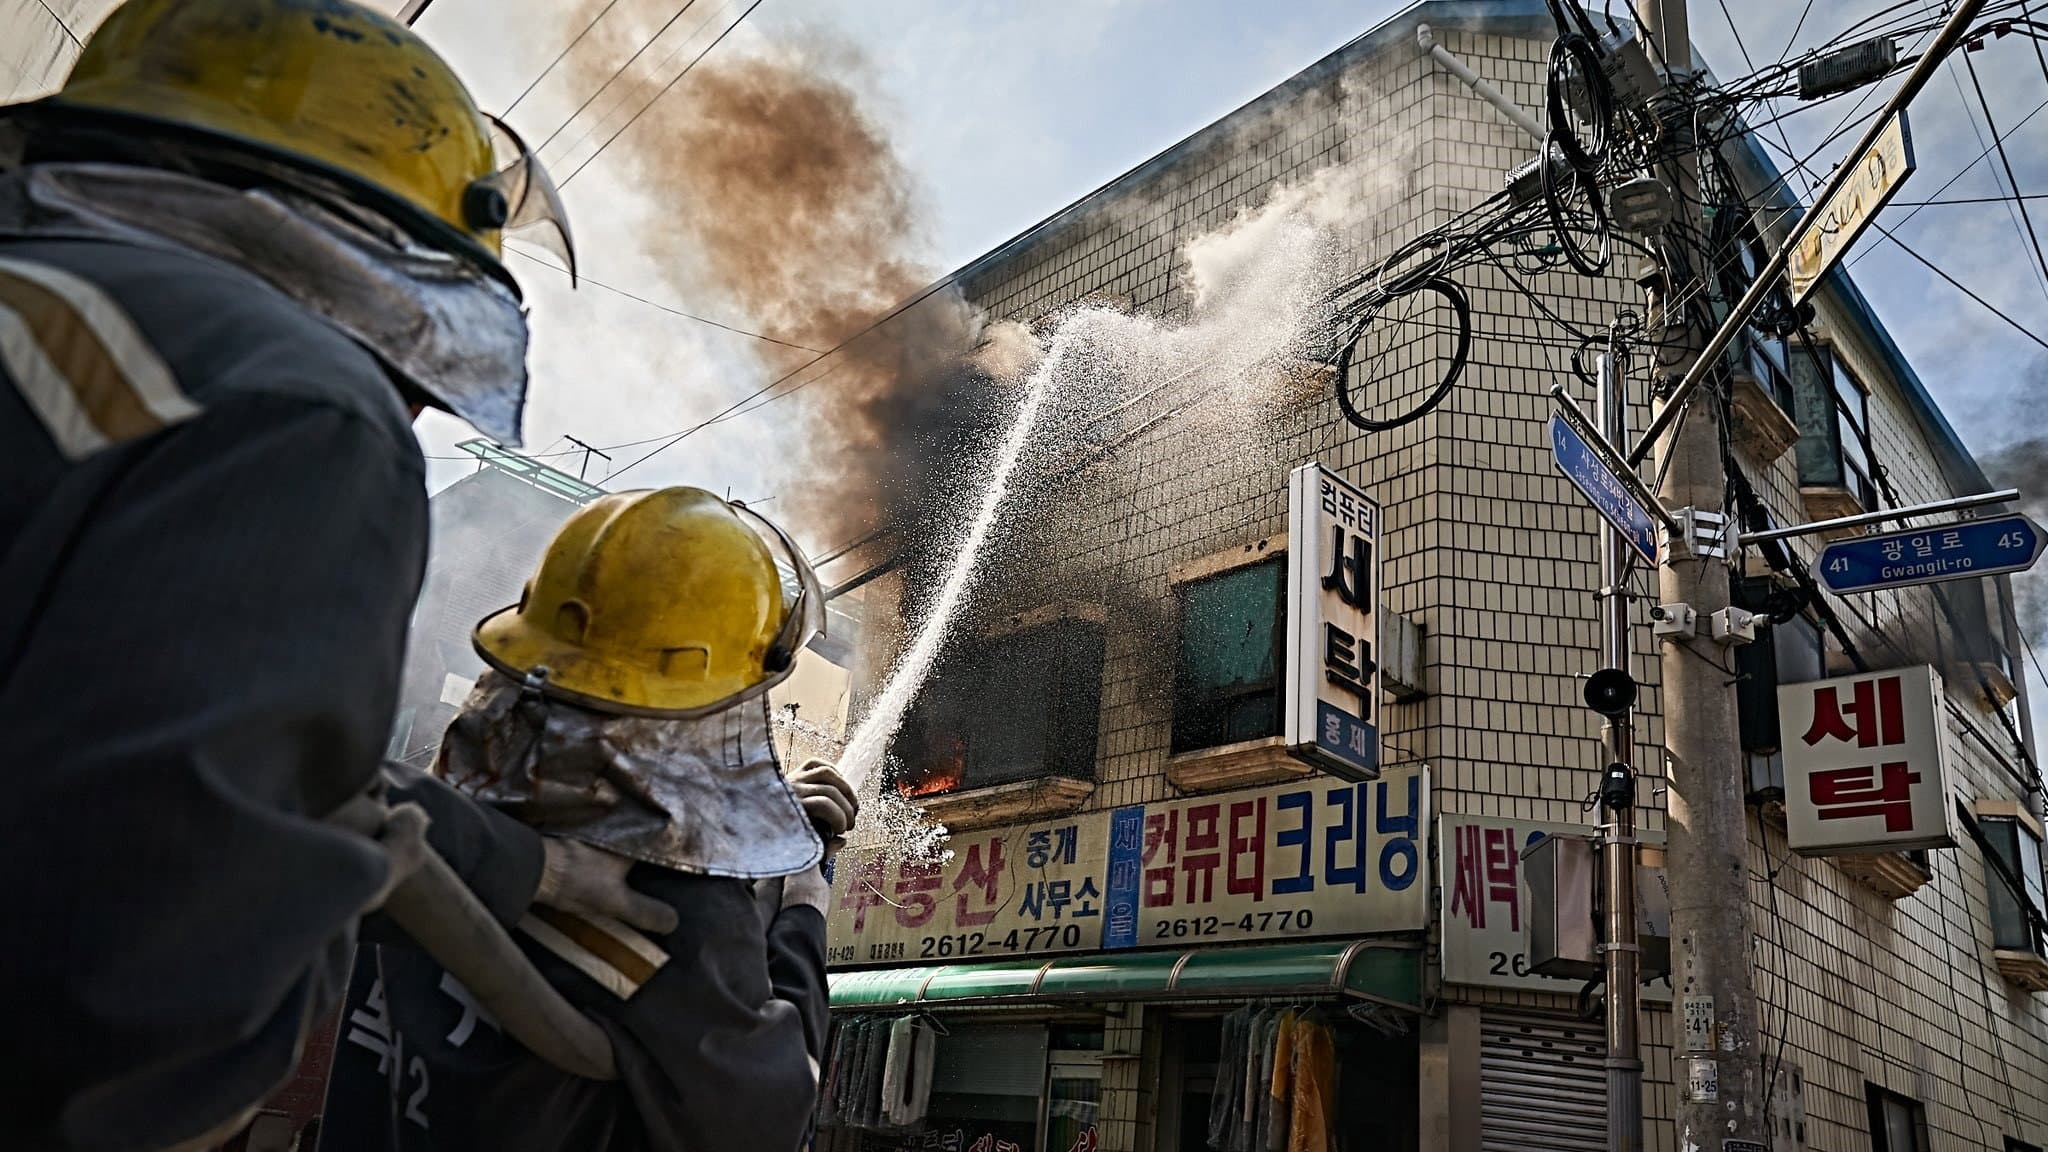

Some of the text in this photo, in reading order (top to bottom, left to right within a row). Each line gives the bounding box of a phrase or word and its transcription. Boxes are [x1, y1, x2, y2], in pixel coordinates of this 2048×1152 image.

[1321, 478, 1373, 540] 컴퓨터
[1882, 531, 1964, 561] 광일로
[1997, 532, 2025, 549] 45
[1829, 557, 1849, 573] 41
[1881, 556, 1972, 579] Gwangil-ro
[1320, 523, 1377, 722] 세탁
[1801, 676, 1922, 833] 세탁
[1026, 824, 1078, 869] 중개
[1110, 817, 1140, 938] 새마을
[1451, 825, 1520, 932] 세탁
[1018, 876, 1100, 921] 사무소
[1155, 908, 1314, 939] 2612-4770
[920, 924, 1081, 959] 2612-4770
[1693, 1017, 1709, 1034] 41
[1691, 1079, 1717, 1093] 11-25
